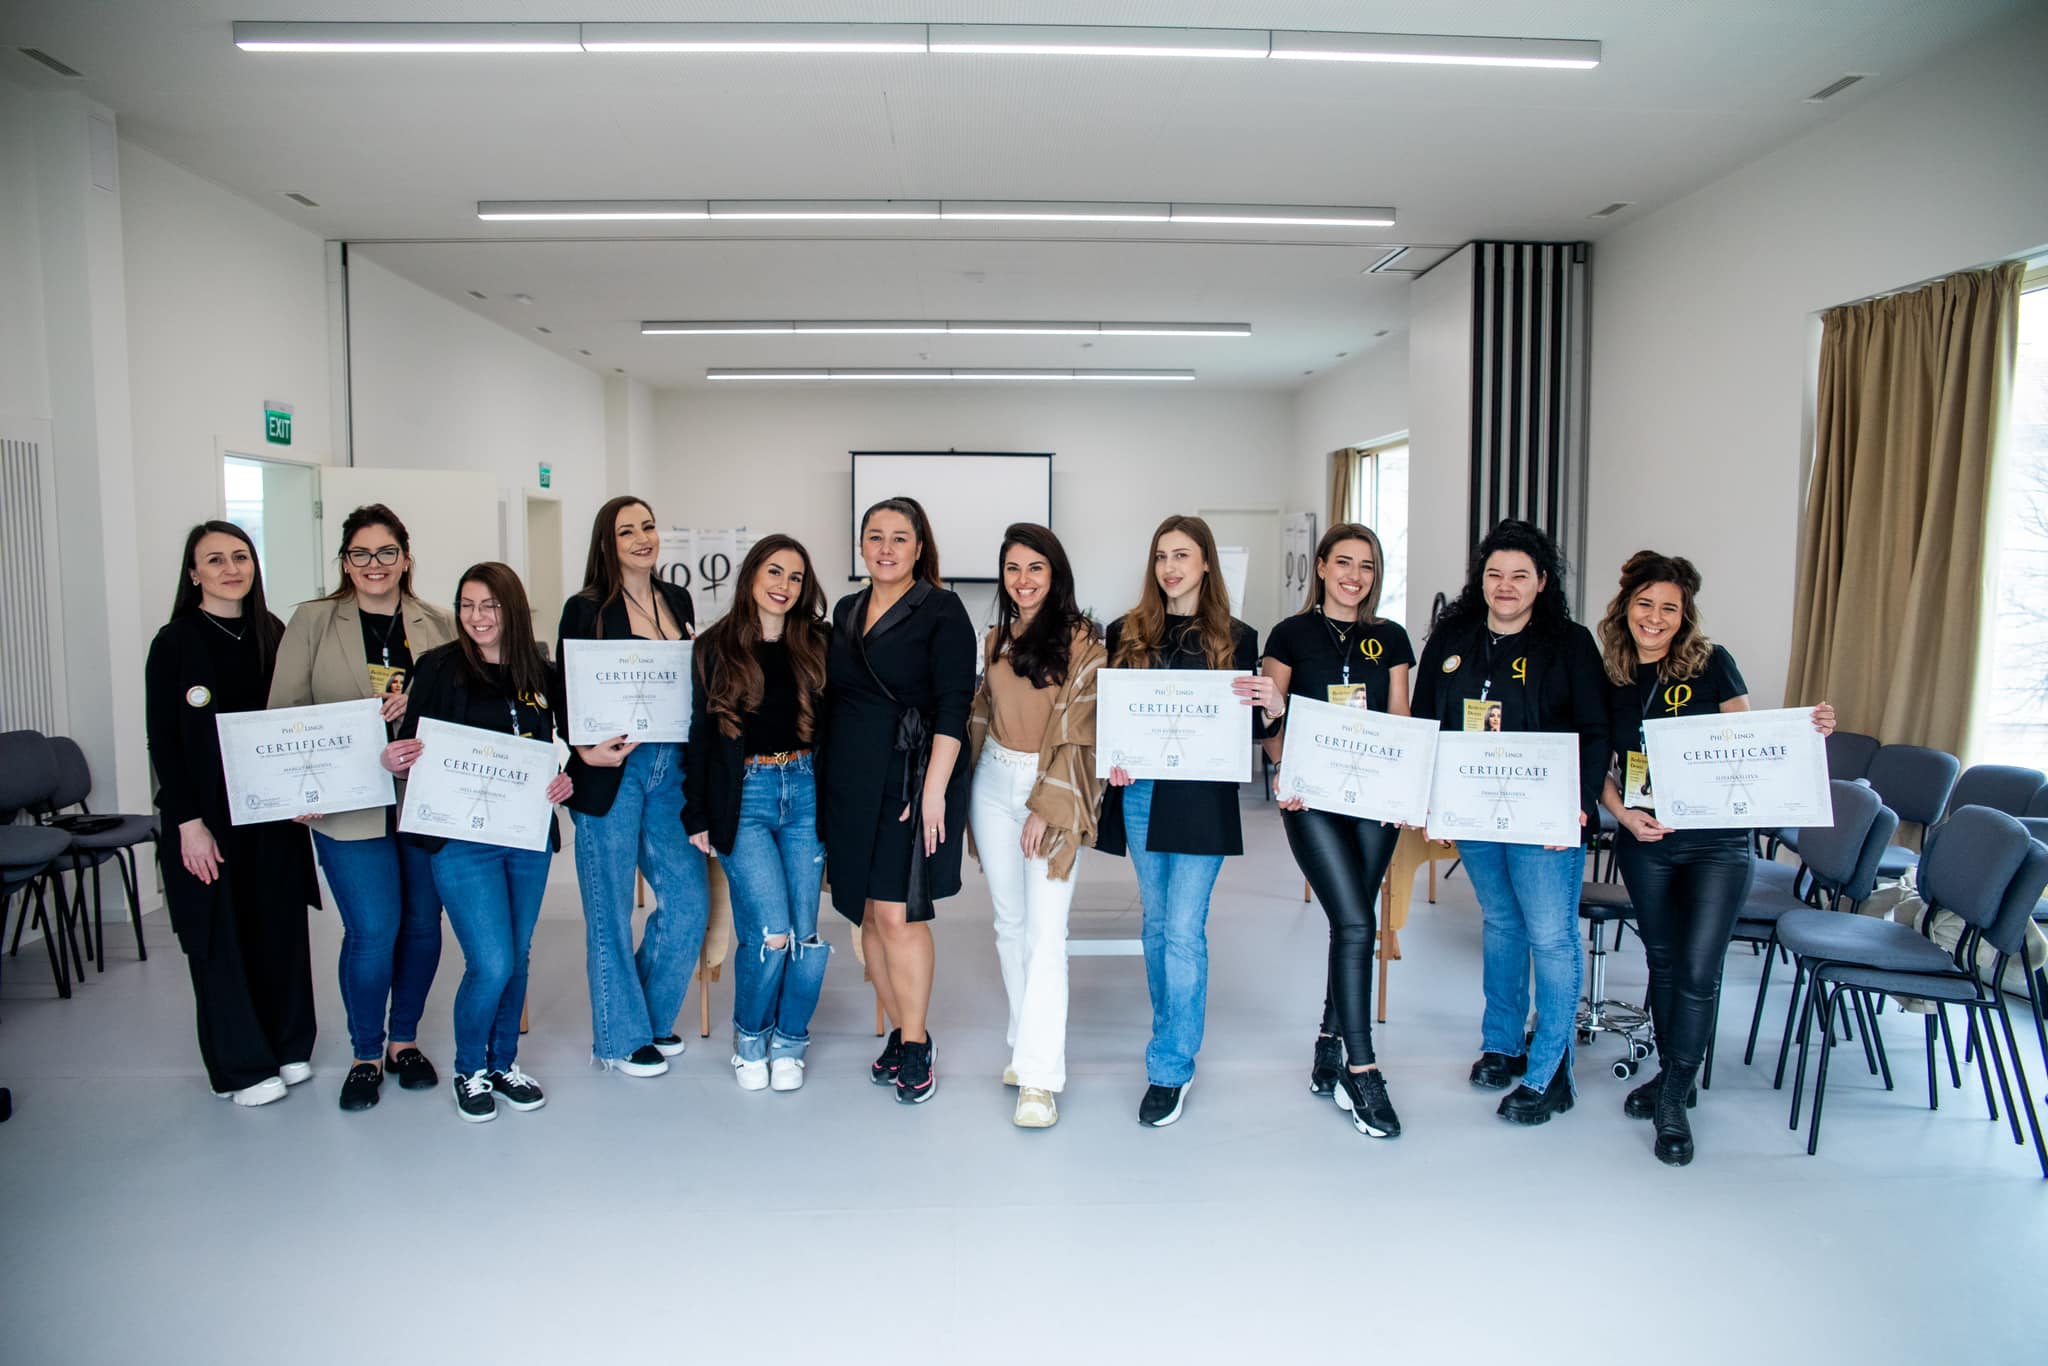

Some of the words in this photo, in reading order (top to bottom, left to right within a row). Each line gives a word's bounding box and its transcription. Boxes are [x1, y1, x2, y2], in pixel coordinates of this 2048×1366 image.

[270, 416, 290, 440] EXIT
[596, 672, 678, 680] CERTIFICATE
[1129, 704, 1220, 714] CERTIFICATE
[256, 735, 354, 755] CERTIFICATE
[1315, 735, 1404, 758] CERTIFICATE
[1684, 745, 1787, 760] CERTIFICATE
[444, 758, 528, 782] CERTIFICATE
[1459, 766, 1548, 777] CERTIFICATE
